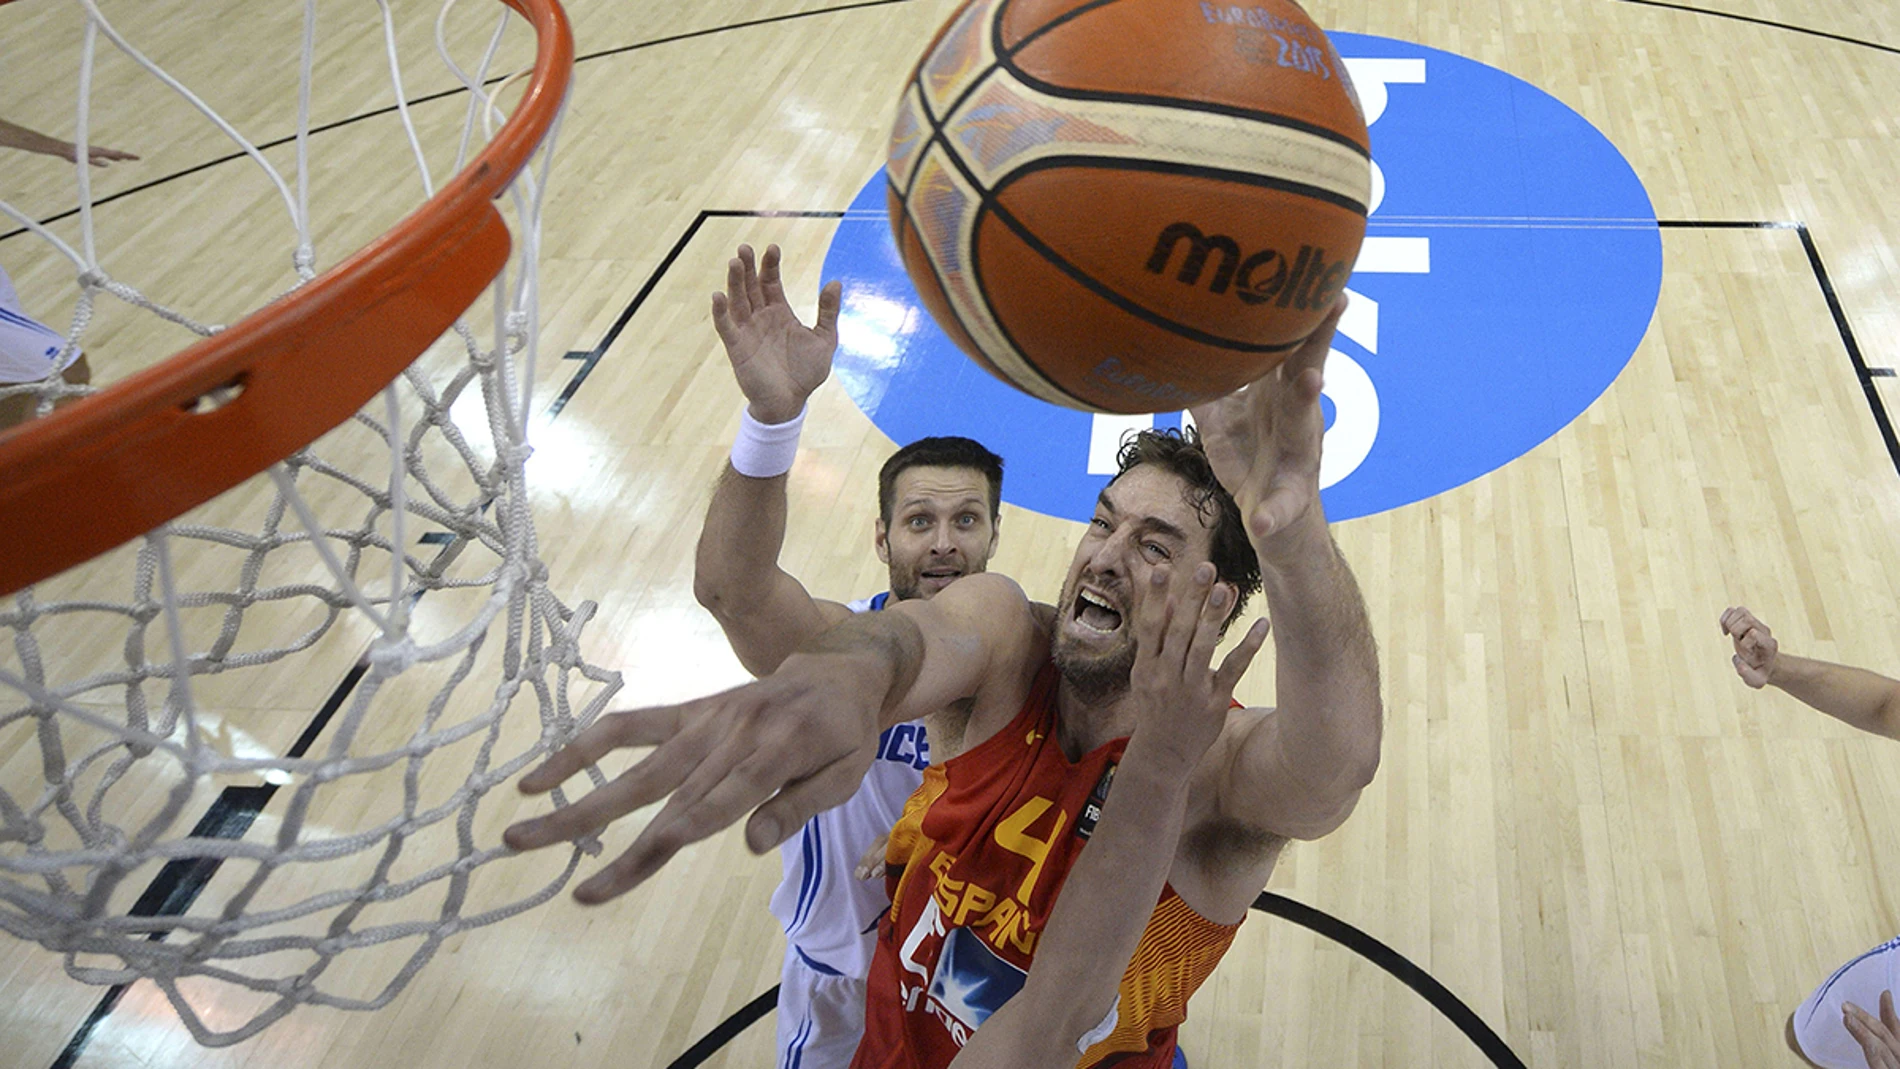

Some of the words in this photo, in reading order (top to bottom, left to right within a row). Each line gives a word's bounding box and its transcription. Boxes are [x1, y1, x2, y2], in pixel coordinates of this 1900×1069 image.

[1269, 33, 1331, 81] 2015
[1146, 222, 1346, 312] molte
[994, 796, 1068, 907] 4
[1084, 804, 1101, 822] FIB
[928, 850, 1037, 956] ESPAÑ
